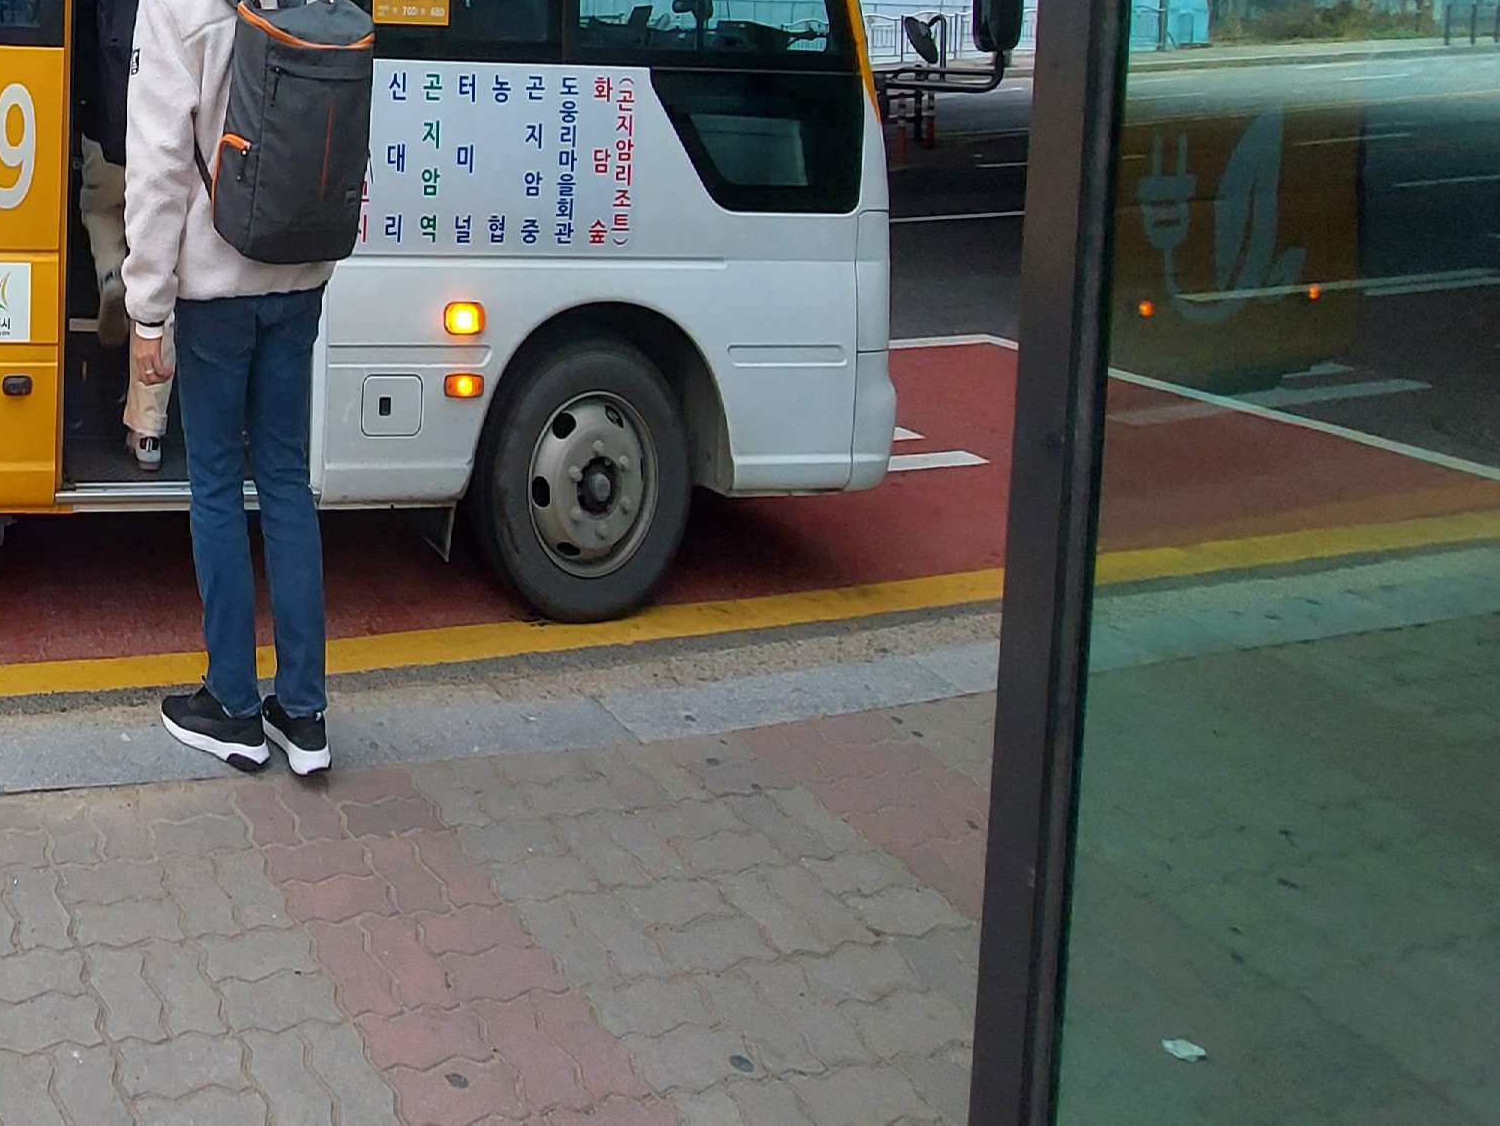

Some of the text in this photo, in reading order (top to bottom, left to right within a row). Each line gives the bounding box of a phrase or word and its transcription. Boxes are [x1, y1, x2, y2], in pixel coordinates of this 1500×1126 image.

[420, 73, 443, 244] 곤지암역
[520, 75, 545, 245] 곤지암중
[554, 77, 579, 245] 도웅리마을회관
[611, 78, 635, 246] (곤지암리조트)
